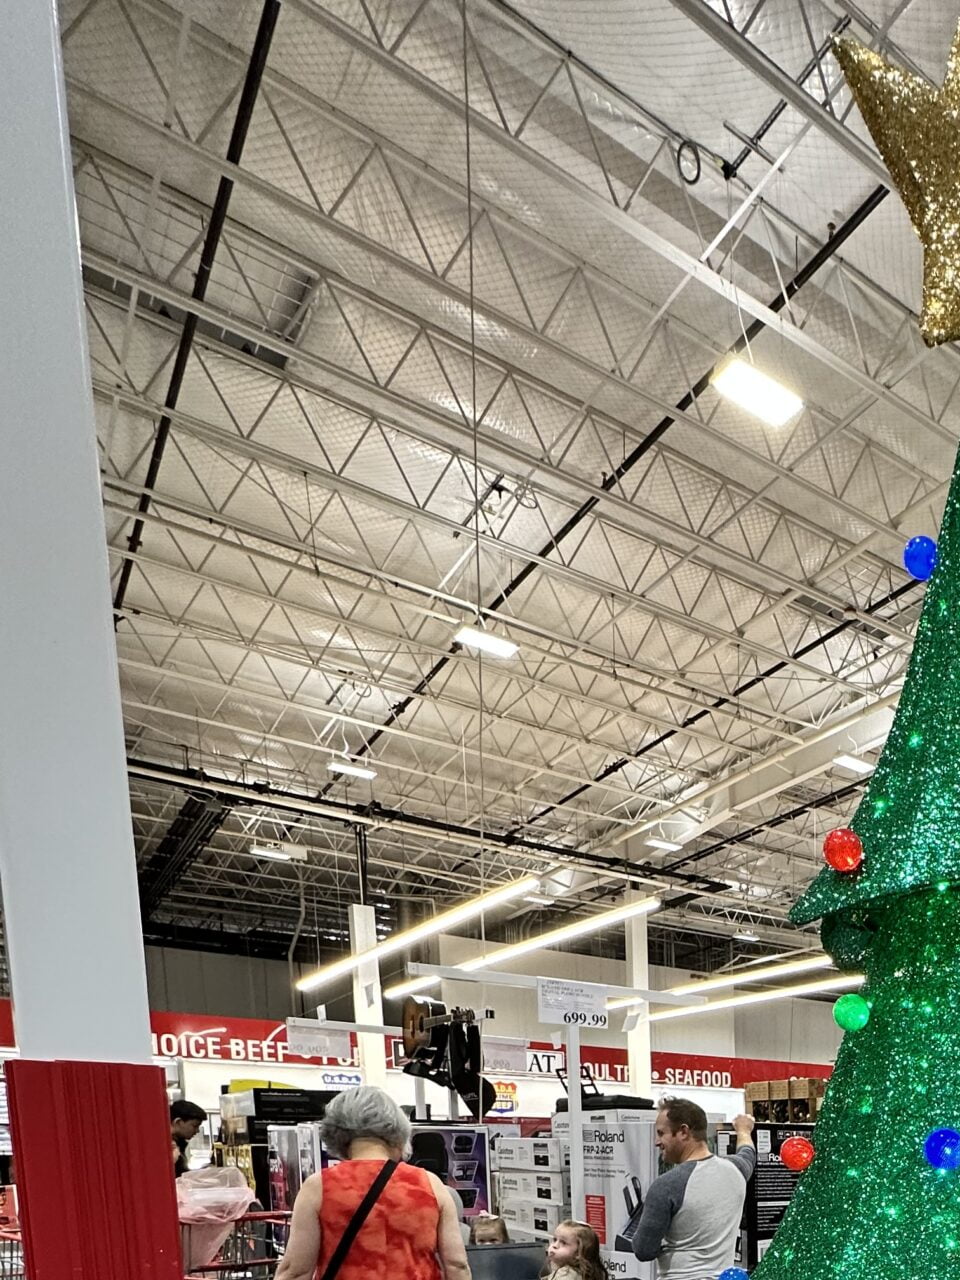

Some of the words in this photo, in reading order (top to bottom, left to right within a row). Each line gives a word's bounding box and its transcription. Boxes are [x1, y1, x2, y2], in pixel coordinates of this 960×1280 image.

[563, 1012, 607, 1026] 699.99
[152, 1032, 222, 1059] OICE
[231, 1038, 288, 1062] BEEF
[528, 1054, 556, 1074] AT
[664, 1068, 732, 1088] SEAFOOD
[594, 1130, 624, 1142] Roland
[602, 1260, 626, 1273] oland
